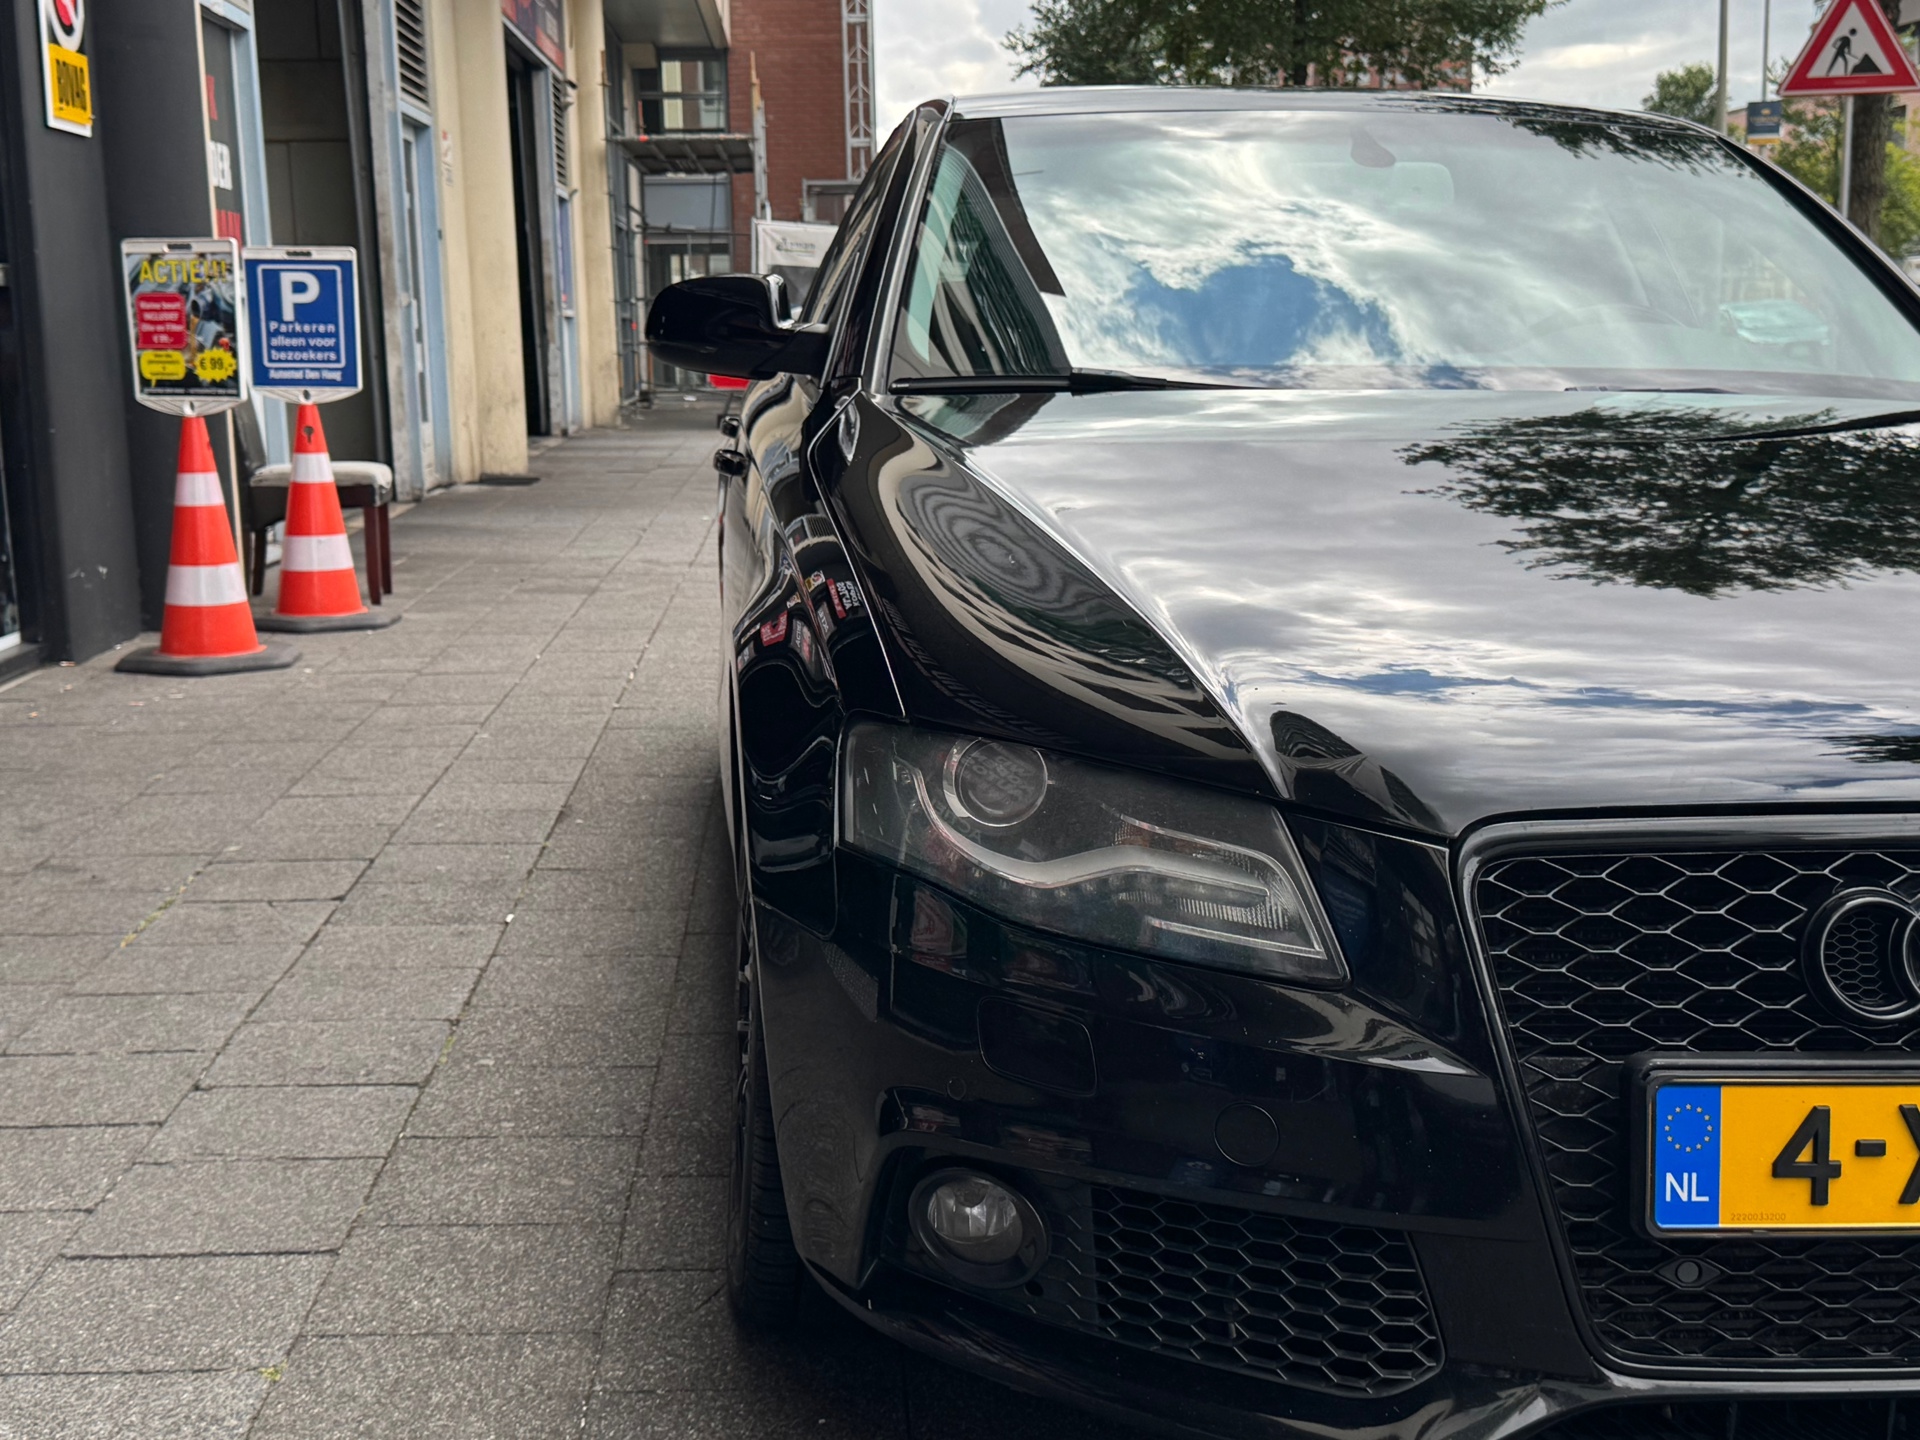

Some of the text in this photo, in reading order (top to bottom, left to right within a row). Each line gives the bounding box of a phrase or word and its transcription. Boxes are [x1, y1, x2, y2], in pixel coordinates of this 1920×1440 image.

[55, 58, 87, 112] BOVAG
[280, 271, 320, 322] P
[269, 320, 336, 333] Parkeren
[270, 334, 336, 347] alleen voor
[271, 349, 337, 361] bezoekers
[1665, 1172, 1710, 1202] NL
